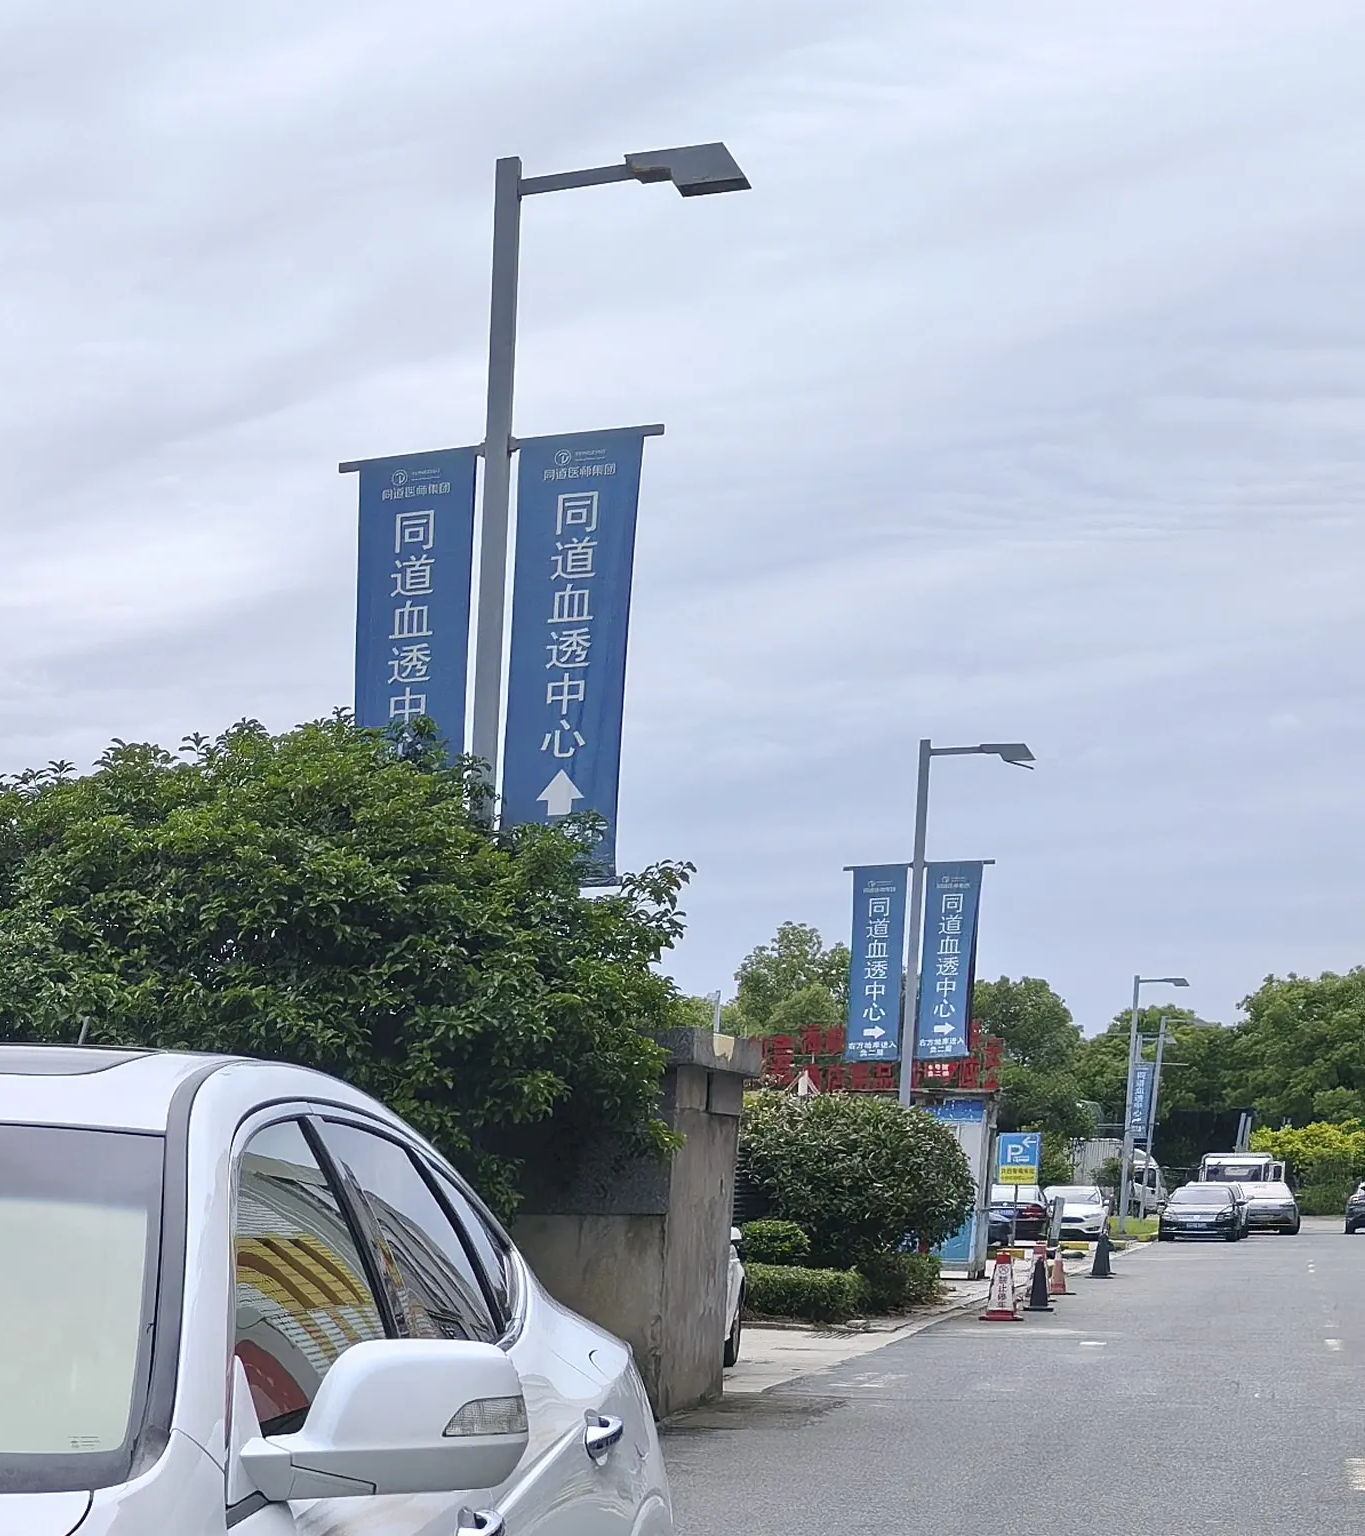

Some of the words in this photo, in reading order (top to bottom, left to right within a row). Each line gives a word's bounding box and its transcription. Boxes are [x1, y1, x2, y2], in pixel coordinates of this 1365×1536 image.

[387, 509, 436, 755] 同道血透中
[540, 491, 599, 758] 同道血透中心
[863, 897, 890, 1022] 同道血透中心
[933, 893, 964, 1018] 同道血透中心
[1006, 1144, 1024, 1163] P
